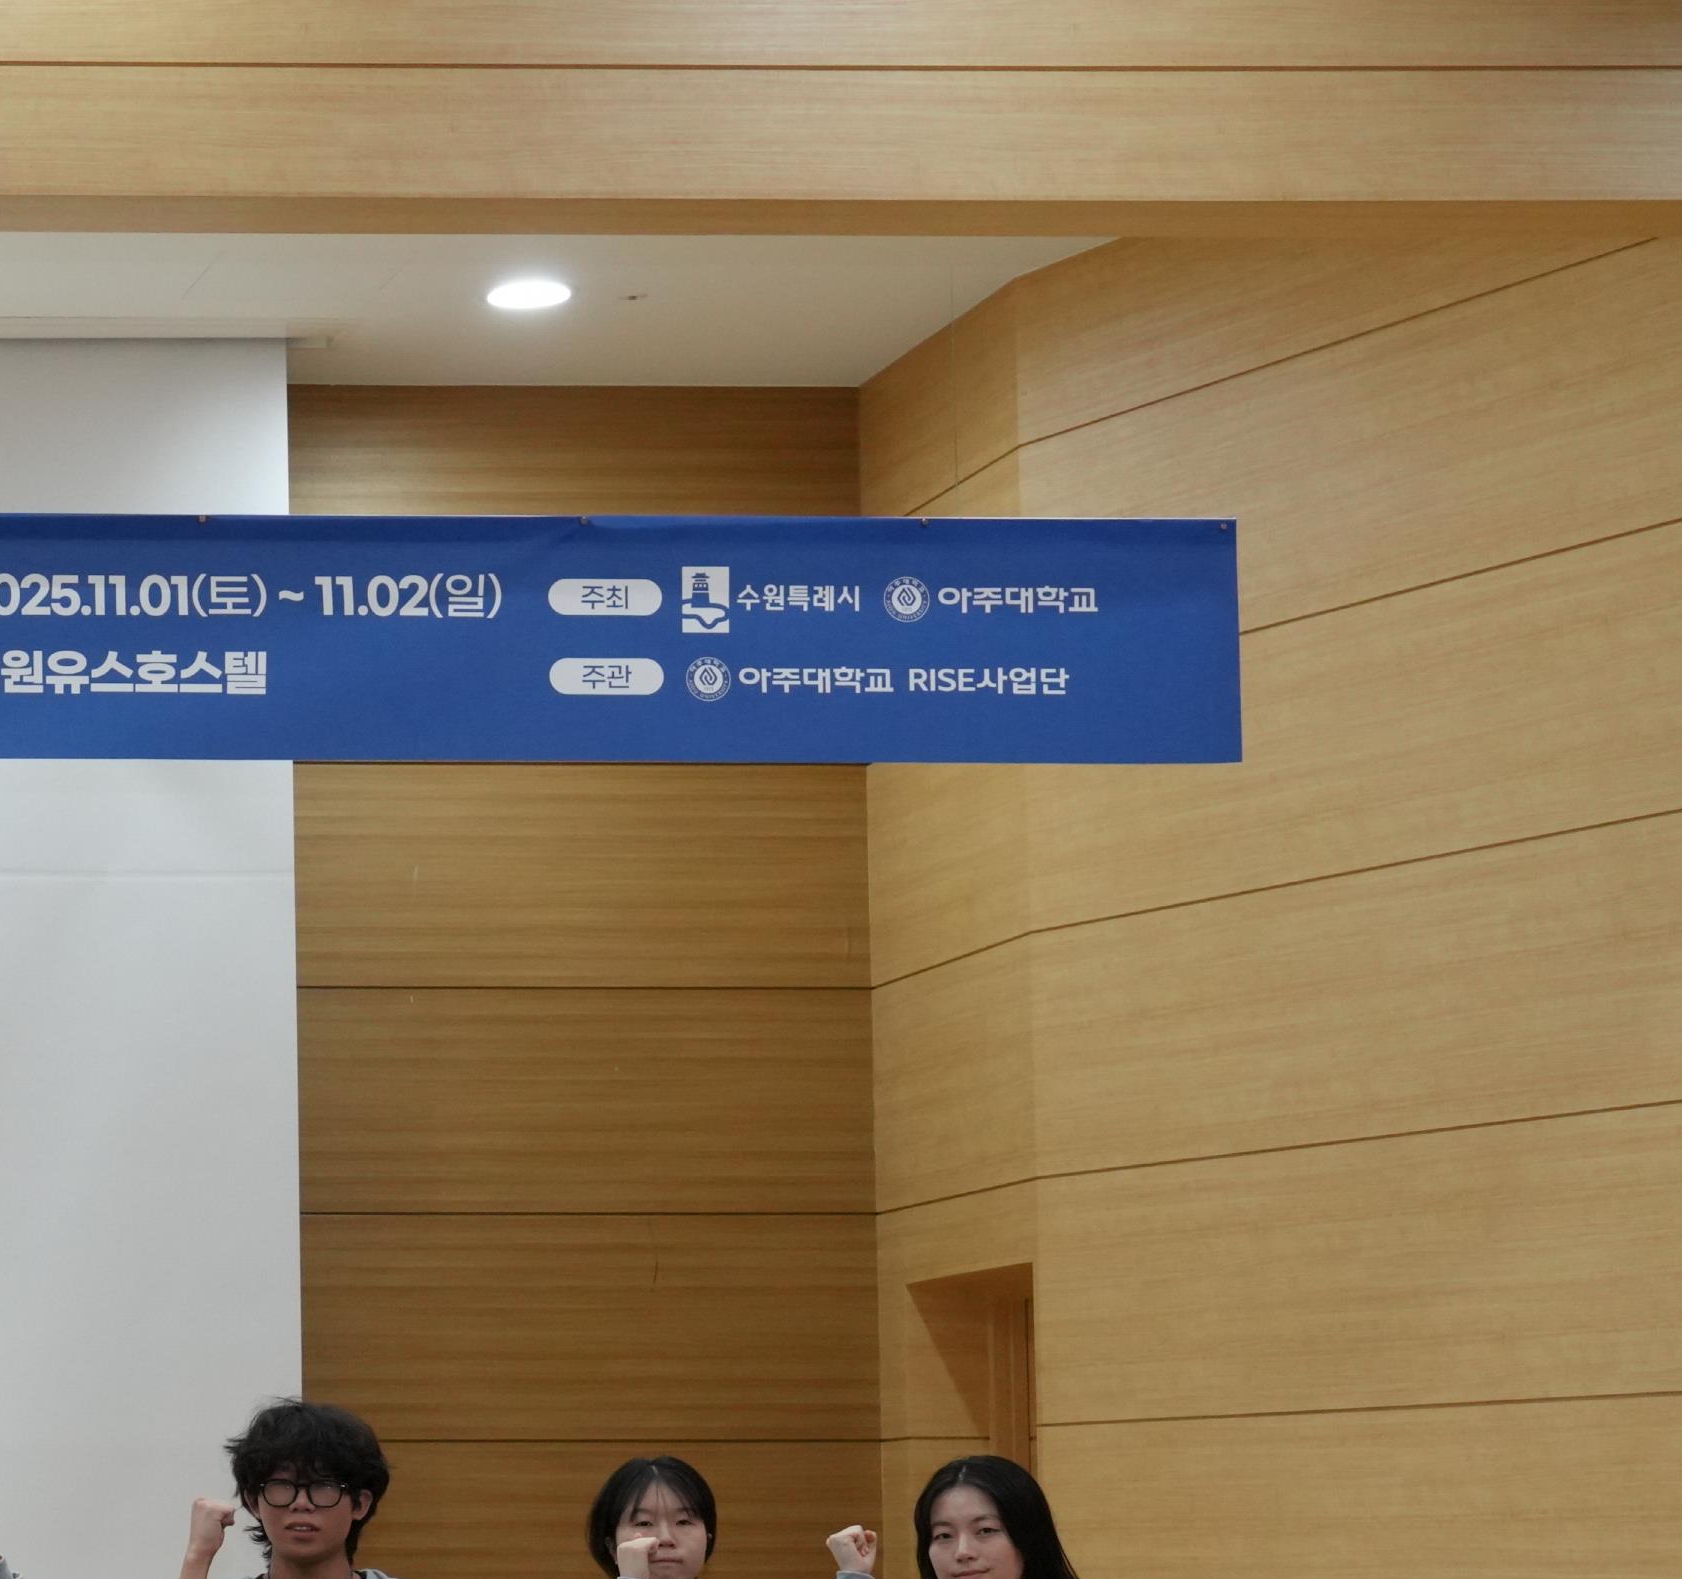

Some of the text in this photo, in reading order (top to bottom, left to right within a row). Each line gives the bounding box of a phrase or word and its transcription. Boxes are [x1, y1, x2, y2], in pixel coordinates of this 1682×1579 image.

[581, 585, 630, 610] 주최
[736, 584, 860, 612] 수원특례시
[938, 585, 1099, 615] 아주대학교
[581, 664, 631, 689] 주관
[738, 666, 894, 694] 아주대학교
[909, 666, 1070, 697] RISE사업단
